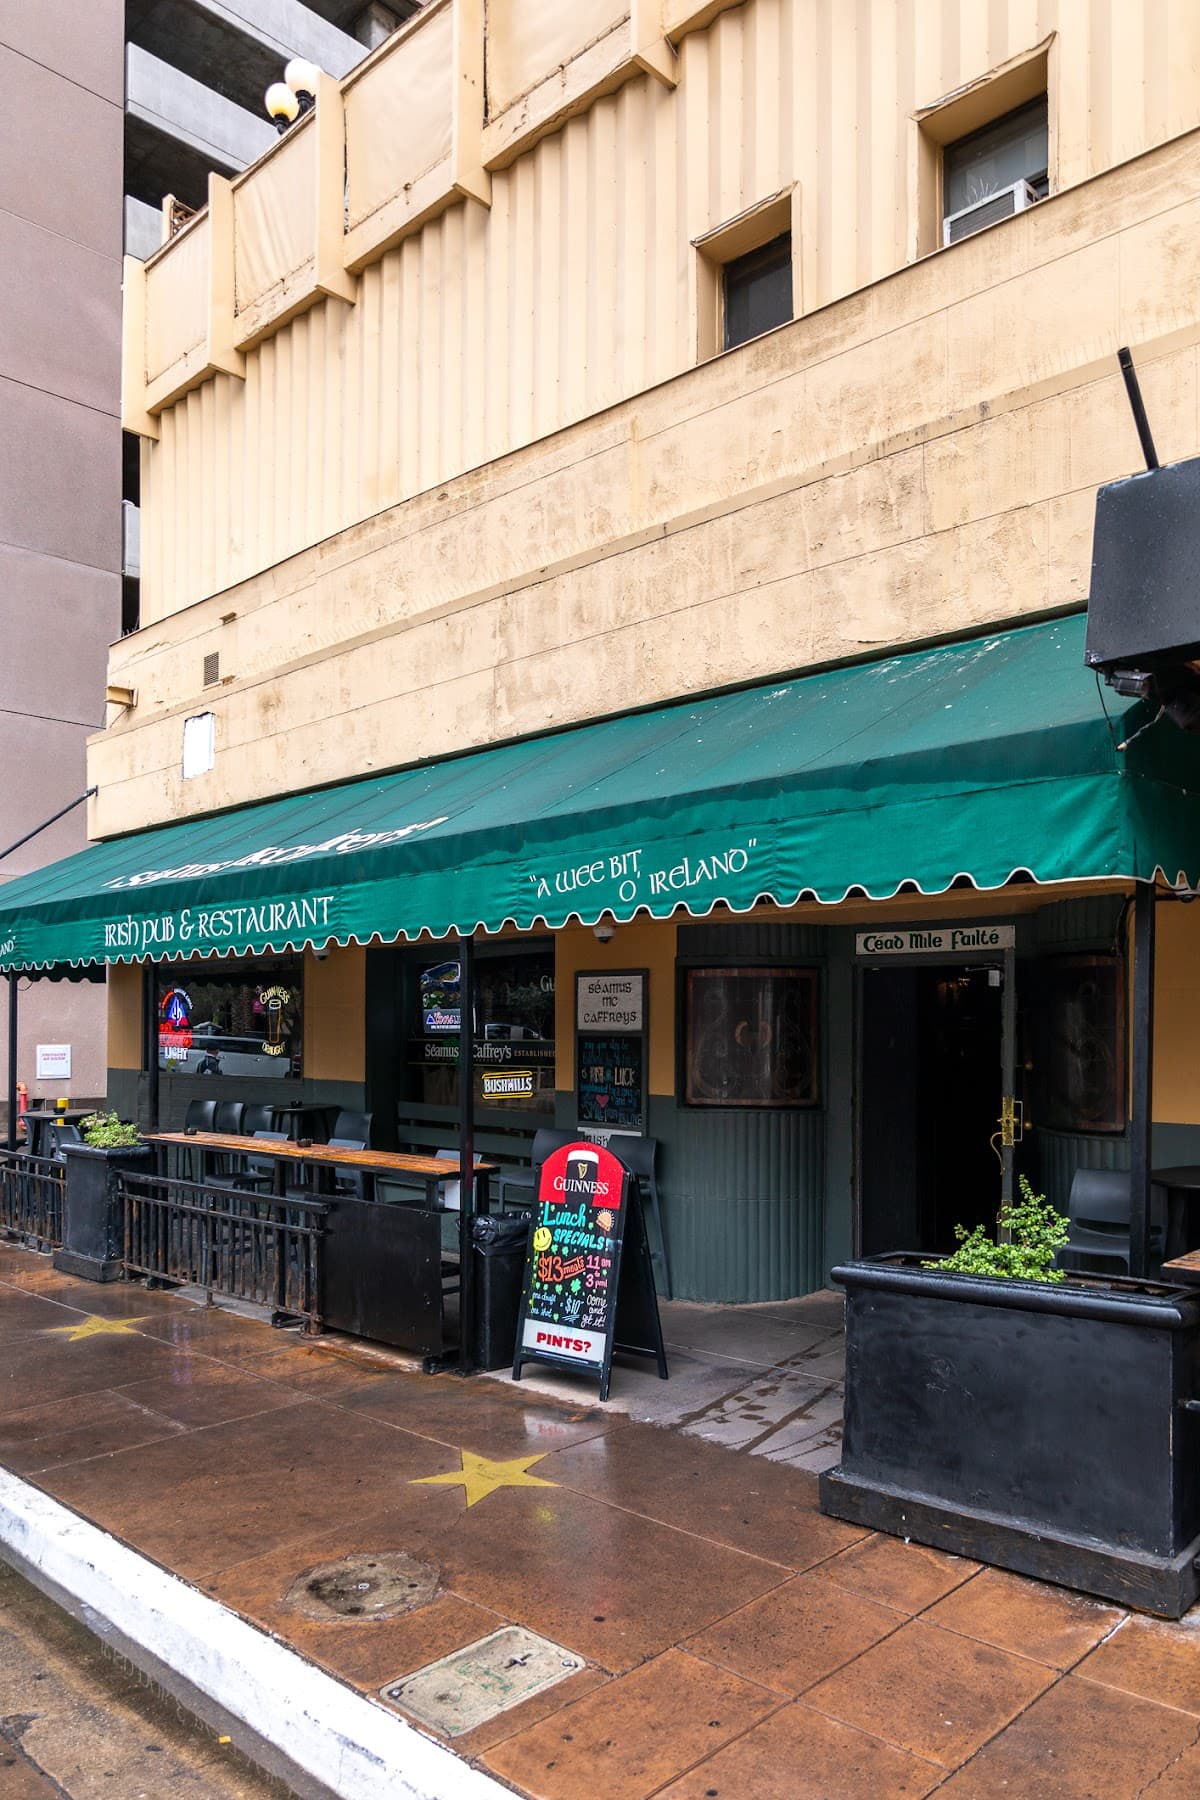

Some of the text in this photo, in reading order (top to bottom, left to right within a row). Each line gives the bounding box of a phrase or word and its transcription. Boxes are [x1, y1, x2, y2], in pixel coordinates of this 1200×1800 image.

[555, 860, 604, 893] WEE
[609, 849, 642, 879] BIT
[142, 917, 174, 951] PUB
[180, 909, 195, 941] &
[198, 896, 335, 936] RESTAURANT
[863, 934, 904, 952] Céad
[425, 1043, 459, 1057] Séamus
[484, 1077, 533, 1093] BUSHMILLS
[553, 1176, 609, 1195] GUINNESS
[543, 1201, 586, 1228] Lunch
[538, 1252, 564, 1283] $13
[586, 1273, 594, 1287] 3
[537, 1332, 592, 1353] PINTS?
